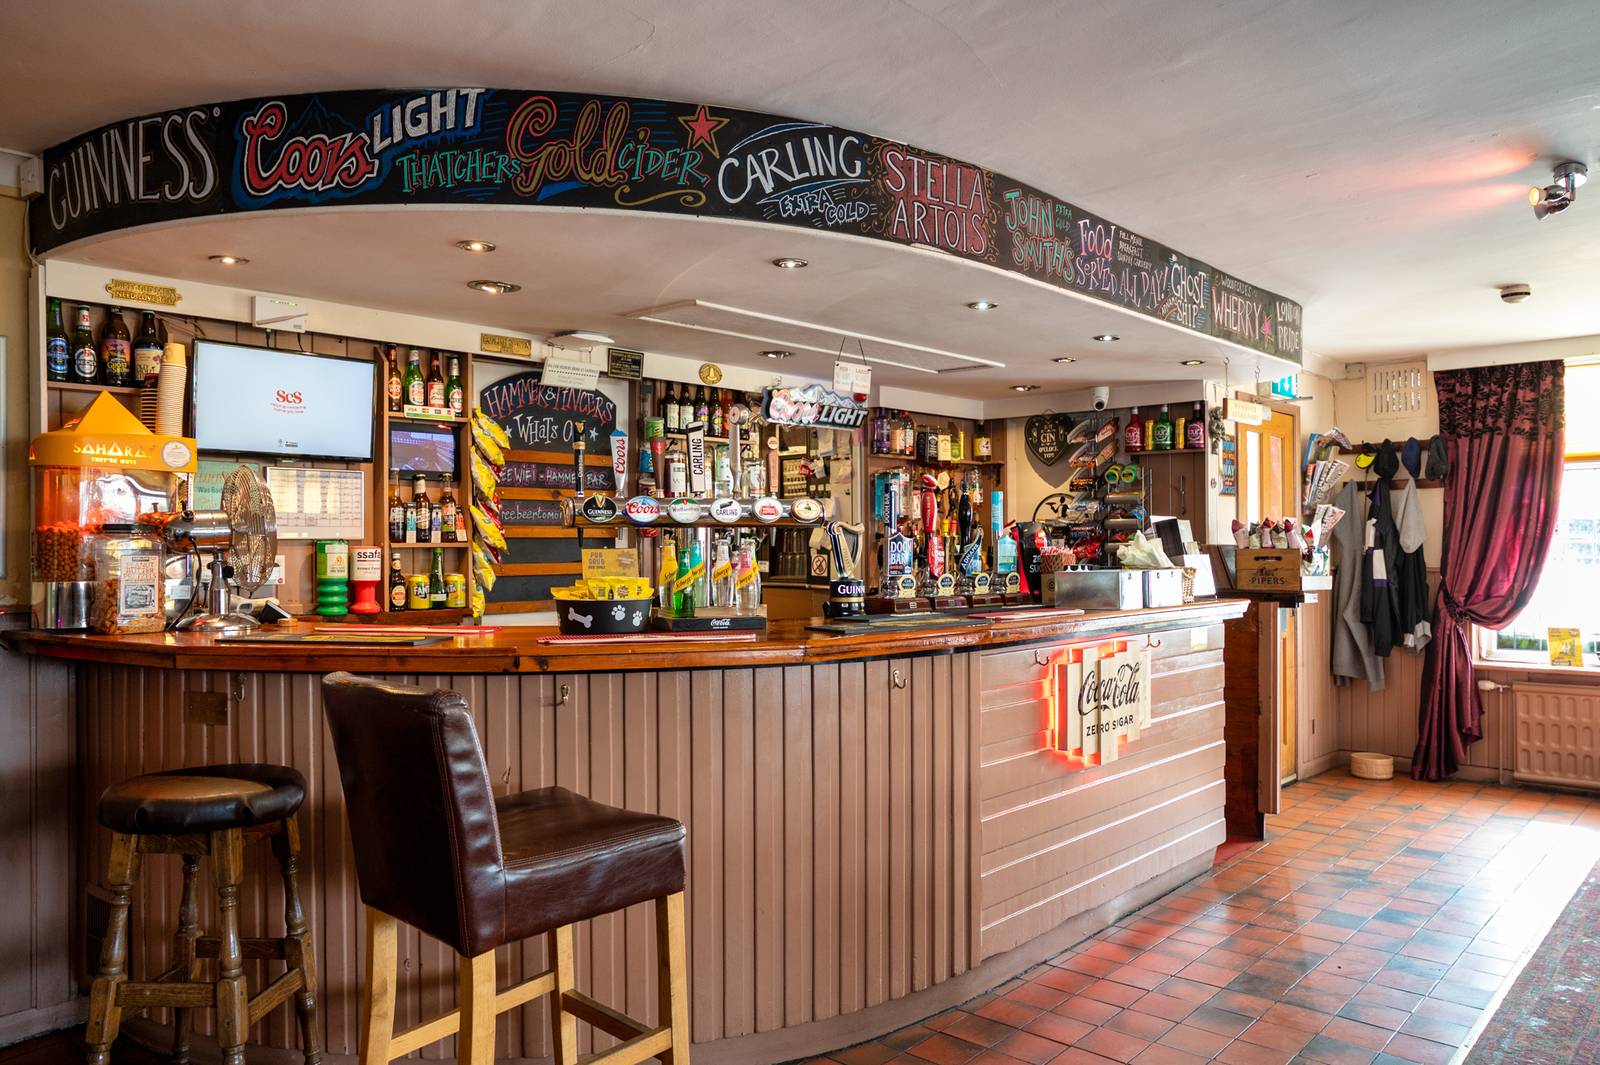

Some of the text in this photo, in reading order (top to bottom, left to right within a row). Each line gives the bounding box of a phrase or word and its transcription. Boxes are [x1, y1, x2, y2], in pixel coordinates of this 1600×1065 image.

[373, 87, 488, 152] LIGHT
[243, 101, 380, 196] Coors
[505, 95, 632, 195] Gold
[48, 108, 217, 231] GUINNESS
[396, 147, 521, 195] THATCHERS
[717, 135, 865, 204] CARLING
[885, 150, 986, 215] STELLA
[778, 188, 834, 217] EXTRA
[825, 203, 871, 225] COLD
[1003, 188, 1057, 240] JOHN
[892, 198, 986, 255] ARTOIS
[1012, 230, 1075, 284] SMITH'S
[1119, 268, 1141, 308] ALL
[1171, 262, 1207, 310] GHOST
[1176, 299, 1199, 329] SHIP
[1211, 286, 1262, 341] WHERRY
[1277, 325, 1300, 353] PRIDE
[275, 389, 303, 404] ScS
[484, 378, 549, 419] HAMMER
[819, 405, 868, 426] LIGHT
[614, 438, 625, 474] Coors
[692, 438, 703, 476] CARLING
[1040, 433, 1056, 443] GIN
[546, 469, 576, 484] HAMME
[586, 472, 608, 486] BAR
[626, 501, 660, 515] Coors
[715, 508, 738, 517] CARLING
[961, 544, 979, 571] ADNAMS
[414, 584, 430, 596] FANT
[1251, 576, 1285, 584] PIPERS
[1078, 661, 1141, 716] Coca-Cola
[1086, 721, 1110, 737] ZERO
